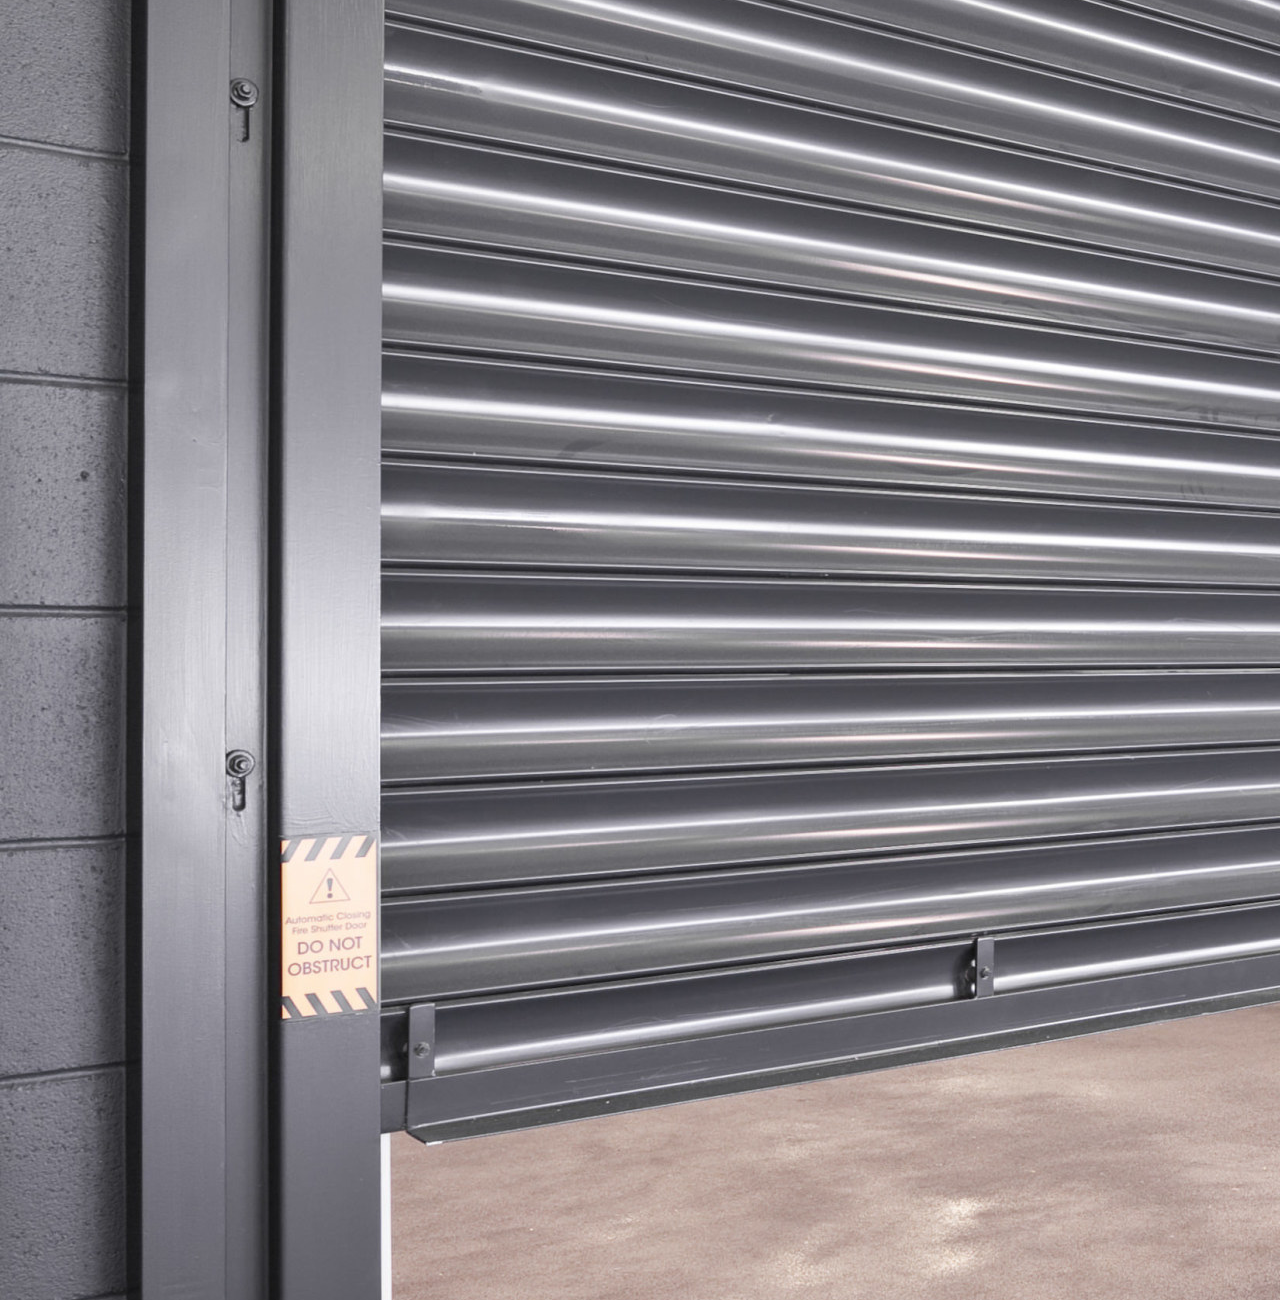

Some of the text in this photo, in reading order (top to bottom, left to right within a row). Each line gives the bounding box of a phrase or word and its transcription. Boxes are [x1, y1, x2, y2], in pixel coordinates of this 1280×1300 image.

[285, 910, 371, 925] Automatic Closing
[292, 921, 367, 935] Fire Shutter Door
[297, 936, 363, 955] DO NOT
[288, 955, 372, 976] OBSTRUCT
